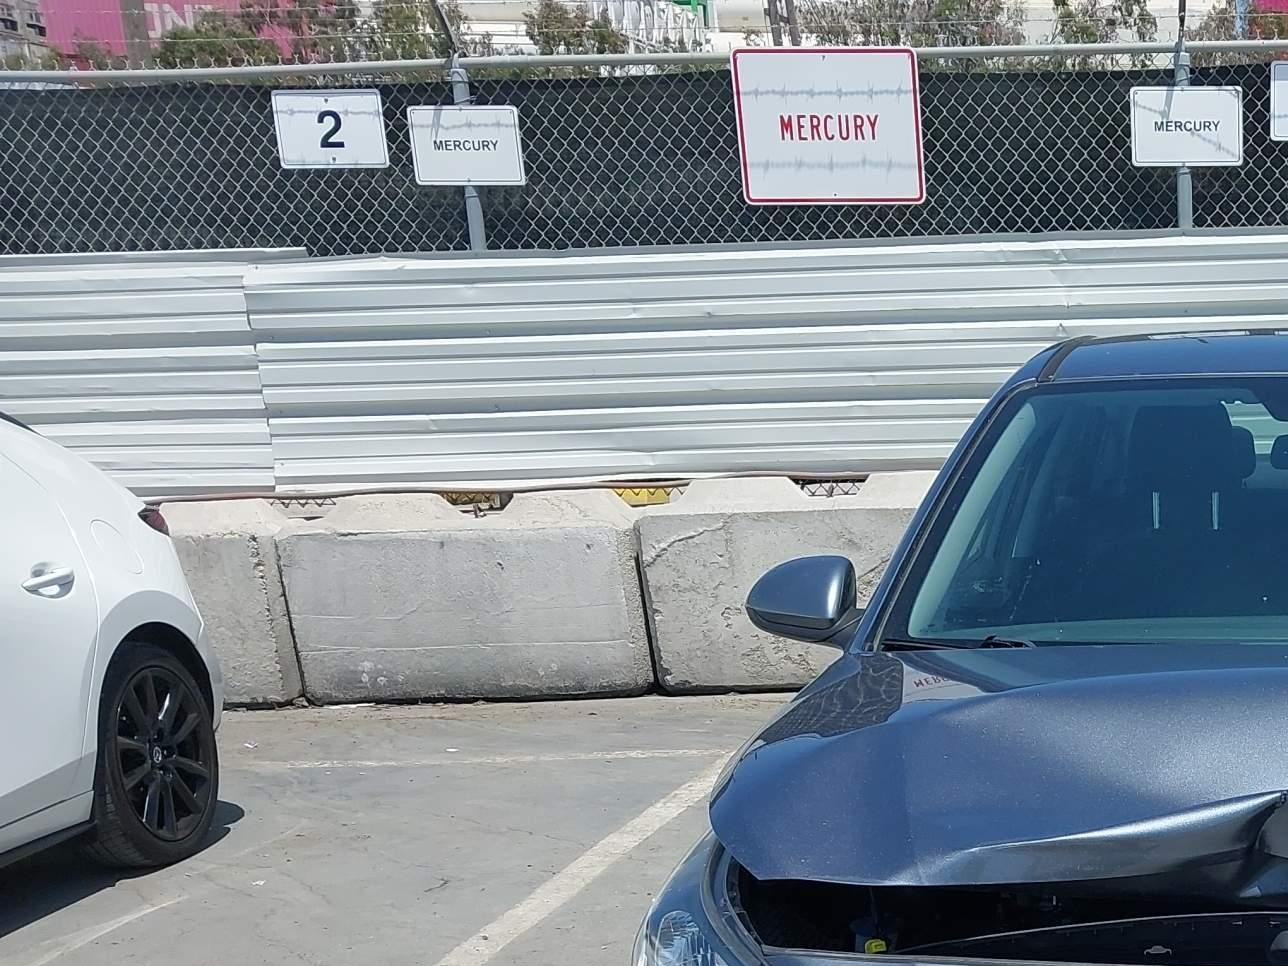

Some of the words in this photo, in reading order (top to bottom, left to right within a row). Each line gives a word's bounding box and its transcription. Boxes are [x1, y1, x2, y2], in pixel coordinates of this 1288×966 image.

[317, 110, 345, 148] 2
[779, 114, 878, 141] MERCURY
[1153, 120, 1221, 133] MERCURY
[433, 140, 499, 152] MERCURY
